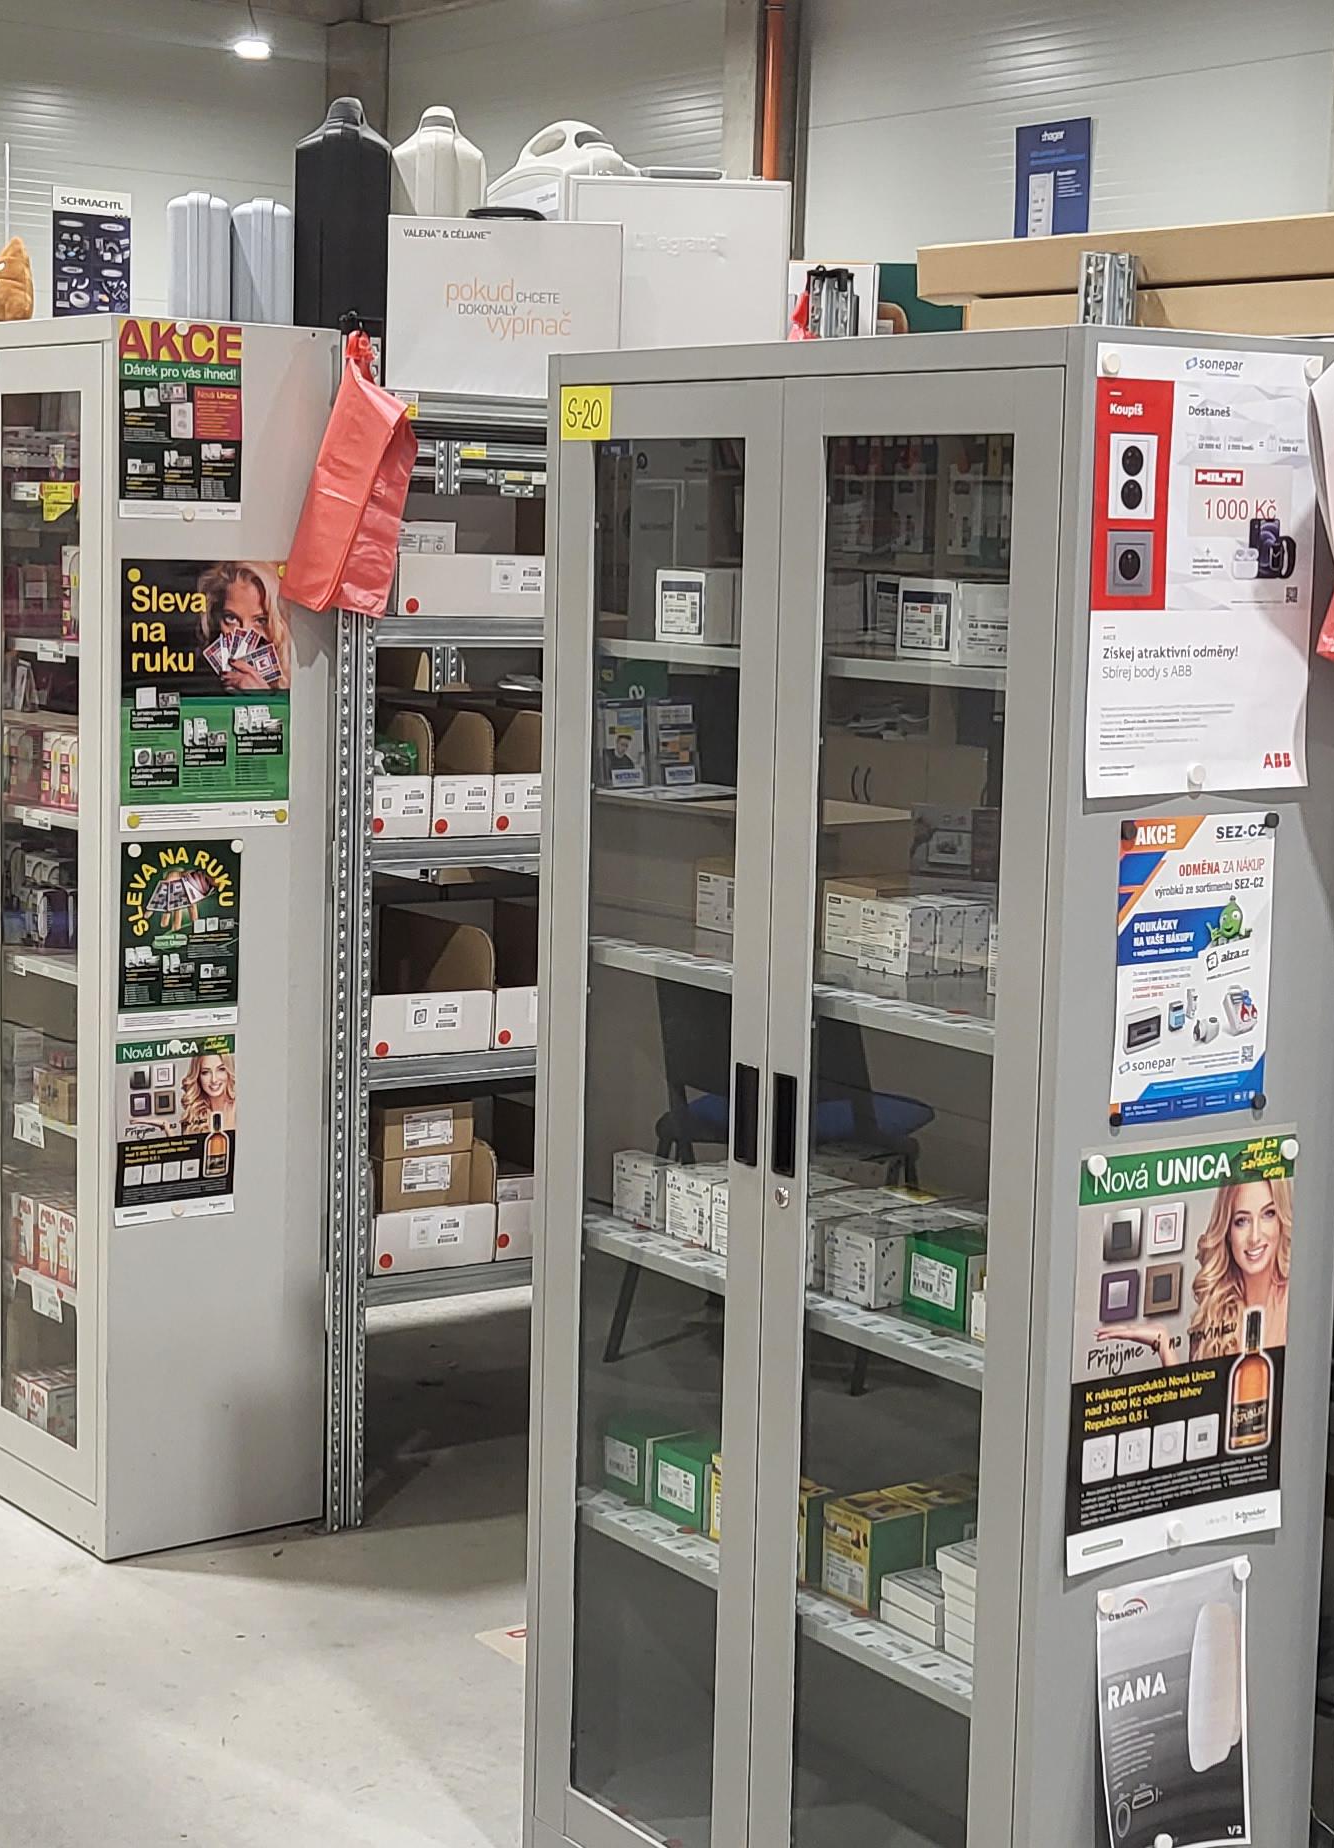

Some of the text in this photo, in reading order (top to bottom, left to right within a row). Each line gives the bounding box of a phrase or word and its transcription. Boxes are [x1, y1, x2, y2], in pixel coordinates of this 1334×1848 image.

[60, 196, 123, 211] SCHMACHTL
[442, 230, 449, 239] &
[445, 277, 560, 307] pokud CHCETE
[486, 312, 572, 341] vypínač
[119, 319, 242, 365] AKCE
[124, 363, 237, 381] Dárek pro vás ihned!
[1198, 358, 1244, 372] sonepar
[566, 397, 603, 430] S-20
[1110, 402, 1143, 418] Koupíš
[1188, 405, 1231, 418] Dostaneš
[1197, 472, 1242, 483] HILTI
[1255, 499, 1277, 520] Kč
[131, 585, 207, 613] Sleva
[131, 621, 166, 643] na
[131, 646, 194, 673] ruku
[1103, 645, 1239, 660] Získej atraktivní odměny!
[1102, 666, 1131, 681] Sbírej
[1134, 666, 1160, 680] body
[1171, 665, 1192, 677] ABB
[1263, 752, 1291, 768] ABB
[1135, 824, 1176, 846] AKCE
[1179, 857, 1265, 877] ODMĚNA ZA NÁKUP
[126, 847, 234, 936] SLEVA NA RUKU
[1155, 885, 1184, 899] výrobků
[1186, 886, 1193, 895] ze
[1234, 877, 1264, 890] SEZ-CZ
[1134, 918, 1178, 933] POUKÁZKY
[1133, 936, 1144, 947] NA
[1145, 933, 1165, 945] VAŠE
[123, 1046, 153, 1060] Nová
[156, 1041, 198, 1057] UCA
[1131, 1057, 1176, 1071] sonepar
[1093, 1152, 1231, 1196] Nová UNICA
[1169, 1336, 1181, 1349] na
[1188, 1320, 1237, 1343] novinku
[1086, 1370, 1215, 1402] K nákupu produktů Nová Unica
[1085, 1404, 1102, 1417] nad
[1104, 1402, 1110, 1412] 3
[1111, 1400, 1127, 1411] 000
[1129, 1396, 1142, 1408] Kč
[1085, 1415, 1127, 1432] Republica
[1129, 1410, 1143, 1423] 0,5
[1107, 1672, 1167, 1711] RANA
[1228, 1825, 1243, 1835] 1/2
